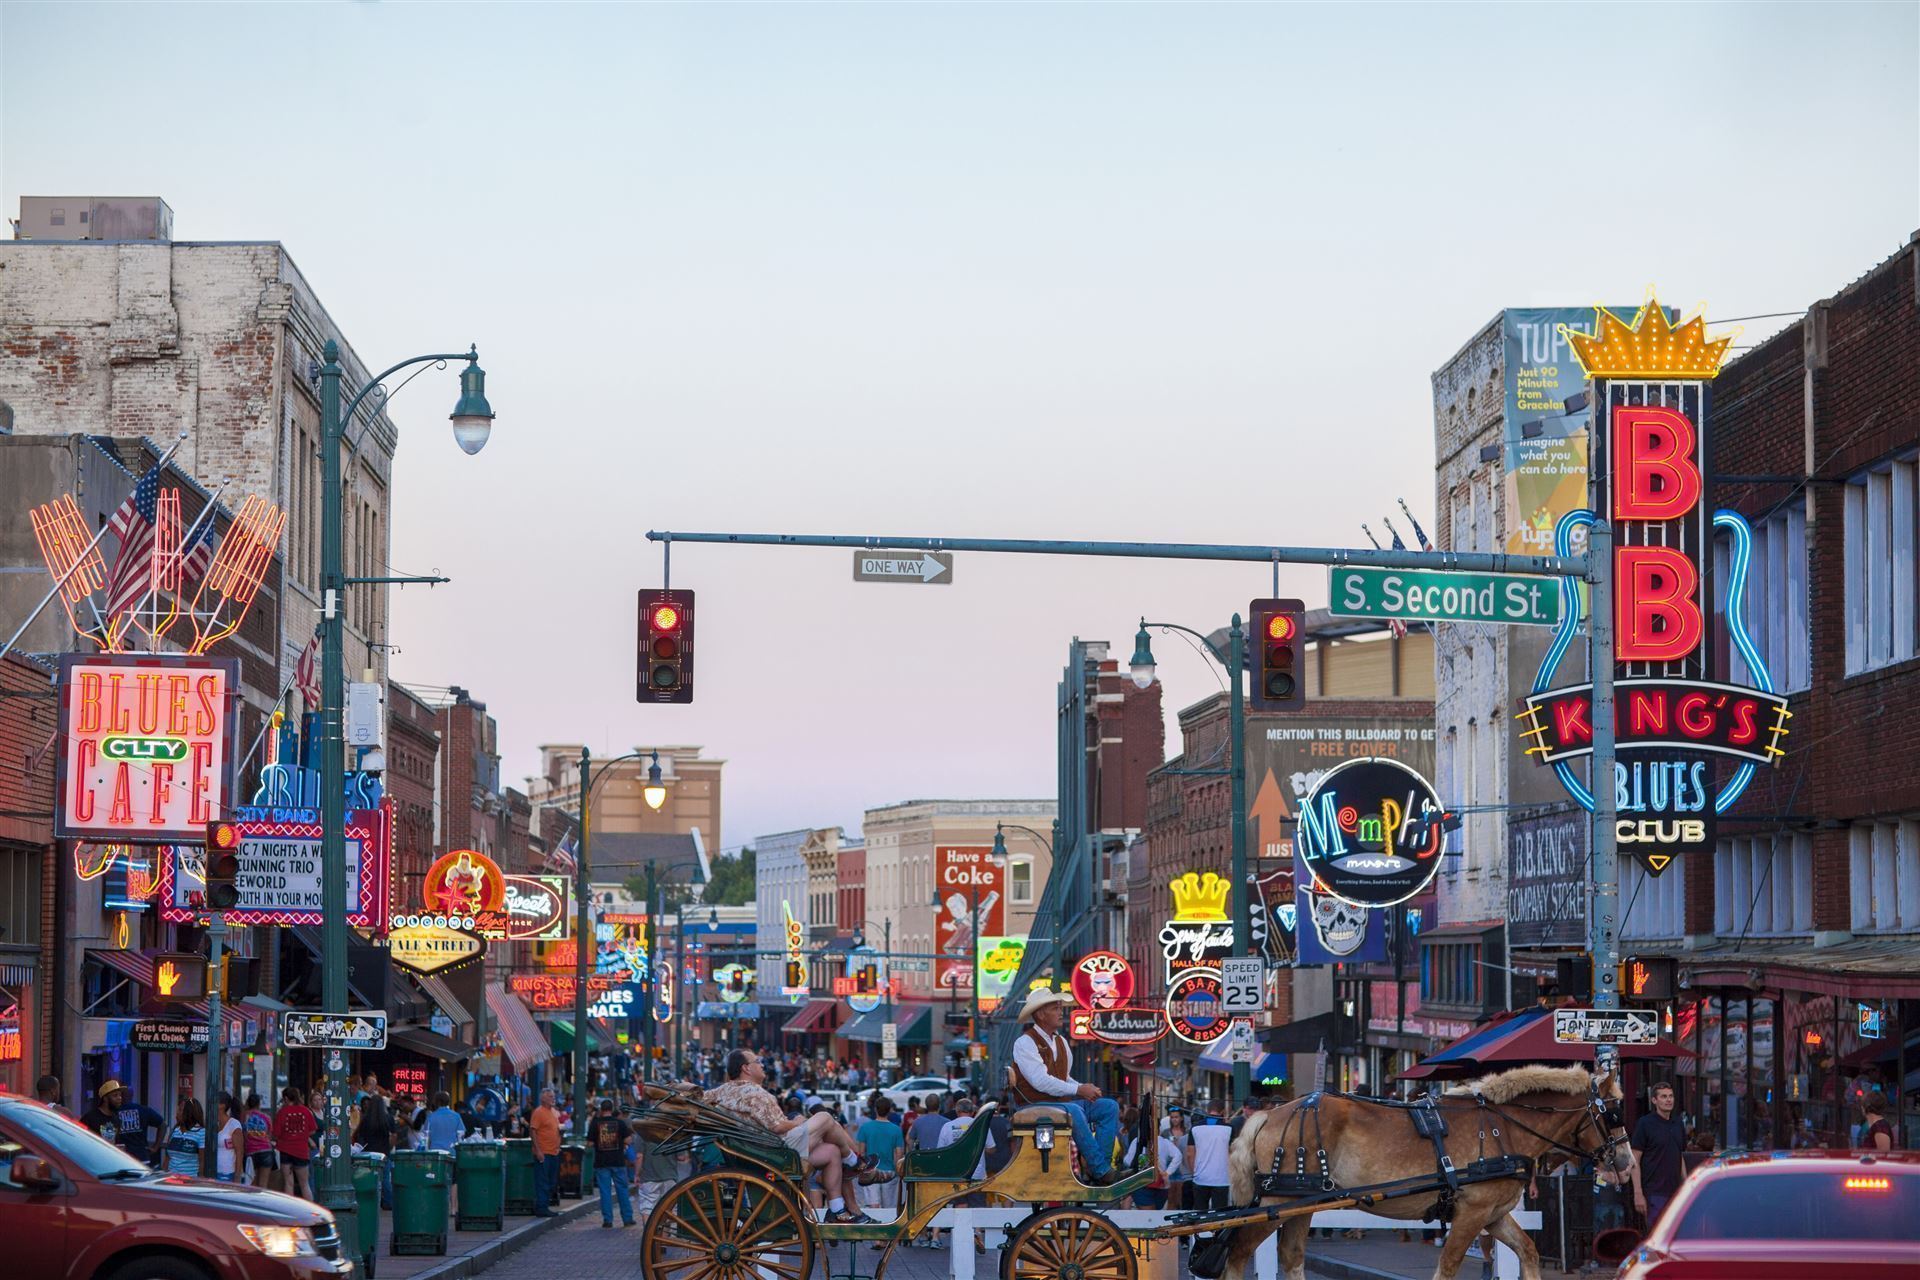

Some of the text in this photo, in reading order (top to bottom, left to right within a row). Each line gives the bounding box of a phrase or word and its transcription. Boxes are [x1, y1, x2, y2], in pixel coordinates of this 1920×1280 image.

[1517, 322, 1591, 363] TUPE
[1517, 367, 1558, 377] Just 90
[1517, 379, 1559, 388] Minutes
[1517, 389, 1542, 399] from
[1517, 400, 1565, 410] Gracelan
[1520, 449, 1571, 462] what you
[1613, 406, 1703, 520] B
[1520, 463, 1587, 474] can do here
[1519, 520, 1588, 550] tupo
[865, 560, 924, 574] ONE WAY
[1343, 574, 1548, 619] S. Second St.
[1613, 546, 1704, 661] B
[77, 673, 218, 736] BLUES
[1551, 689, 1759, 746] KNG'S
[1266, 728, 1314, 740] MENTION
[1317, 729, 1342, 740] THIS
[1345, 729, 1401, 740] BILLBOARD
[1404, 730, 1418, 740] TO
[109, 739, 183, 757] CITY
[1310, 742, 1397, 757] FREE COVER
[75, 738, 213, 825] CAFE
[1615, 761, 1706, 812] BLUES
[236, 806, 269, 822] CITY
[272, 808, 318, 824] BAND
[1615, 820, 1706, 844] CLUB
[252, 843, 258, 856] 7
[262, 844, 298, 857] NIGHTS
[301, 845, 307, 857] A
[946, 849, 994, 863] Have a
[289, 861, 314, 874] TRIO
[944, 865, 995, 885] Coke
[237, 891, 260, 905] OUTH
[264, 892, 273, 905] IN
[276, 893, 301, 905] YOUR
[1508, 881, 1585, 923] COMPANY STORE
[425, 939, 476, 951] STREET
[549, 953, 577, 966] ROO
[1079, 956, 1127, 975] PIG
[1172, 960, 1193, 968] HALL
[1224, 963, 1260, 973] SPEED
[1185, 977, 1217, 993] BAR
[1228, 975, 1257, 984] LIMIT
[533, 992, 577, 1007] CAF
[1226, 986, 1260, 1006] 25
[136, 1024, 209, 1034] First Chance RIBS
